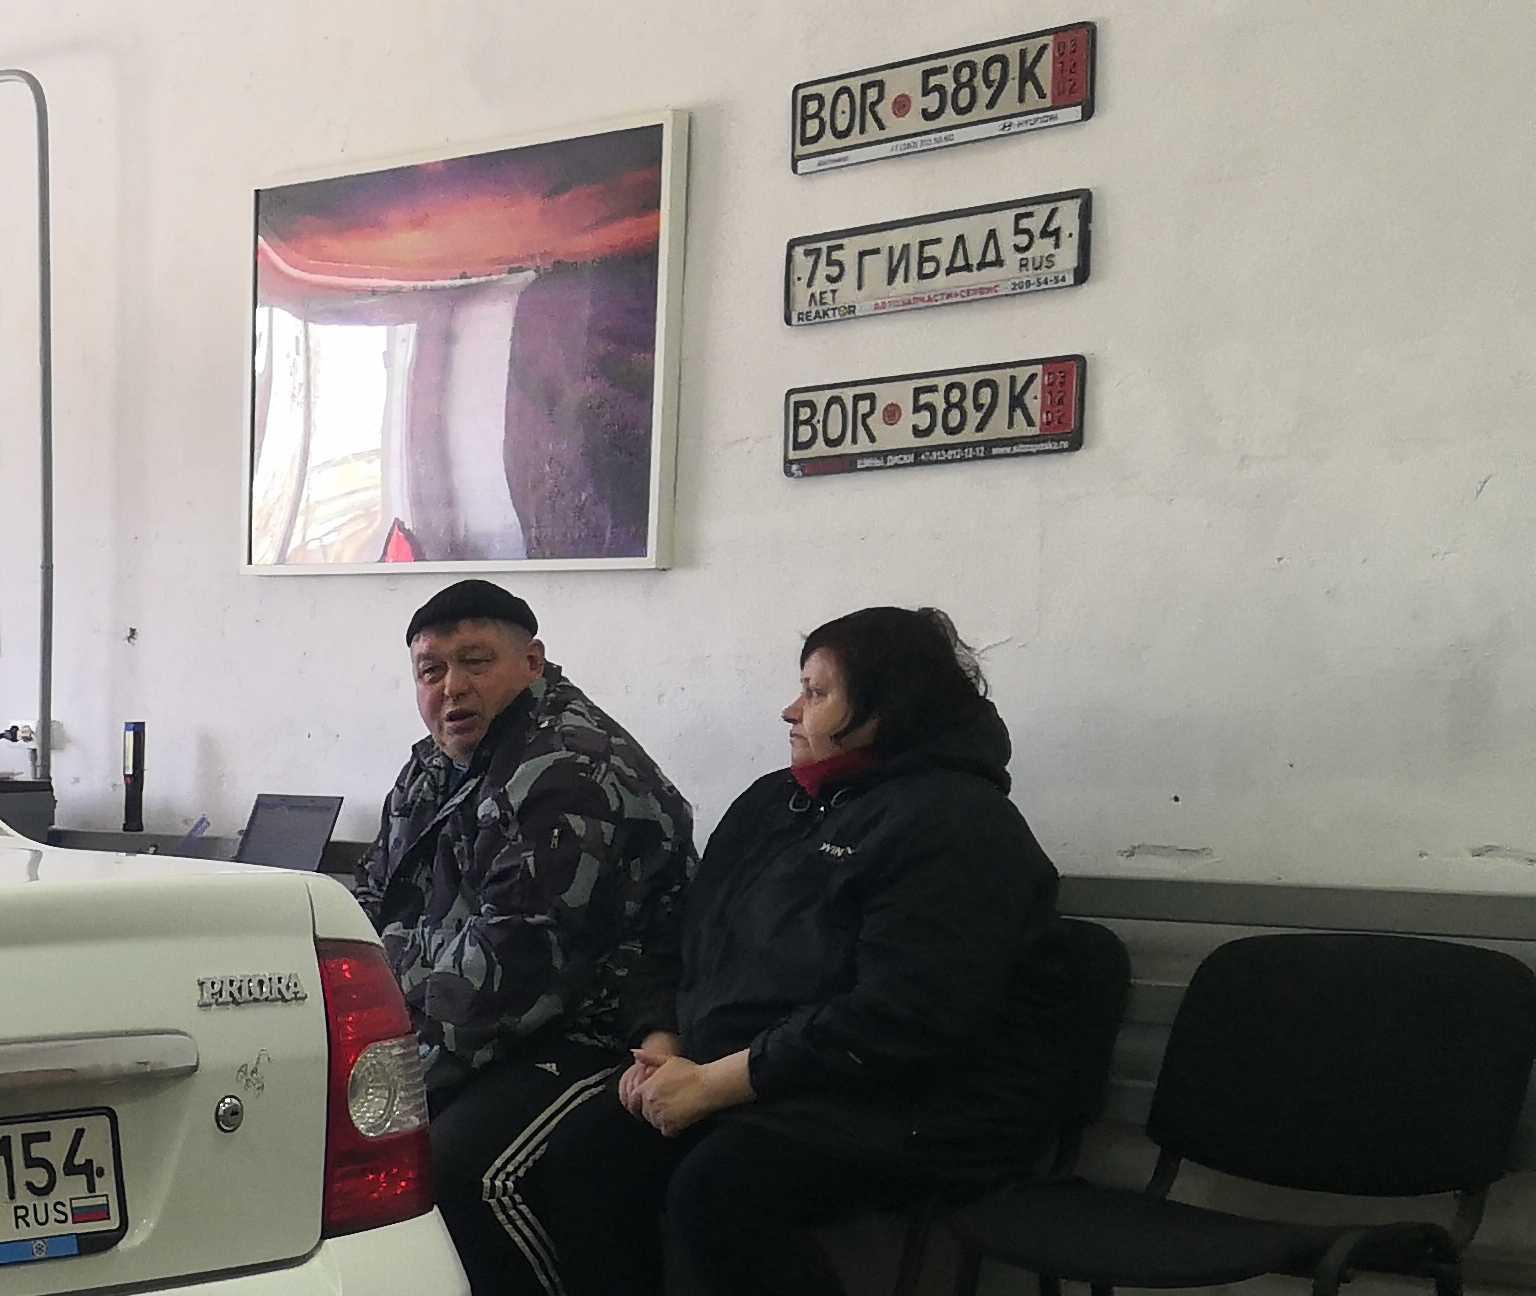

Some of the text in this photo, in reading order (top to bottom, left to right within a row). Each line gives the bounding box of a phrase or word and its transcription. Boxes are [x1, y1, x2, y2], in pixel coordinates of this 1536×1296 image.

[799, 42, 1050, 147] BOR 589K
[1013, 207, 1062, 254] 54
[803, 244, 845, 290] 75
[856, 229, 1005, 290] ГИБДД
[1019, 254, 1056, 273] RUS
[797, 304, 857, 323] REAKTOR
[809, 288, 838, 307] ЛЕТ
[792, 372, 1039, 451] BOR 589K
[198, 973, 307, 1008] PRIORA
[14, 1199, 68, 1230] RUS
